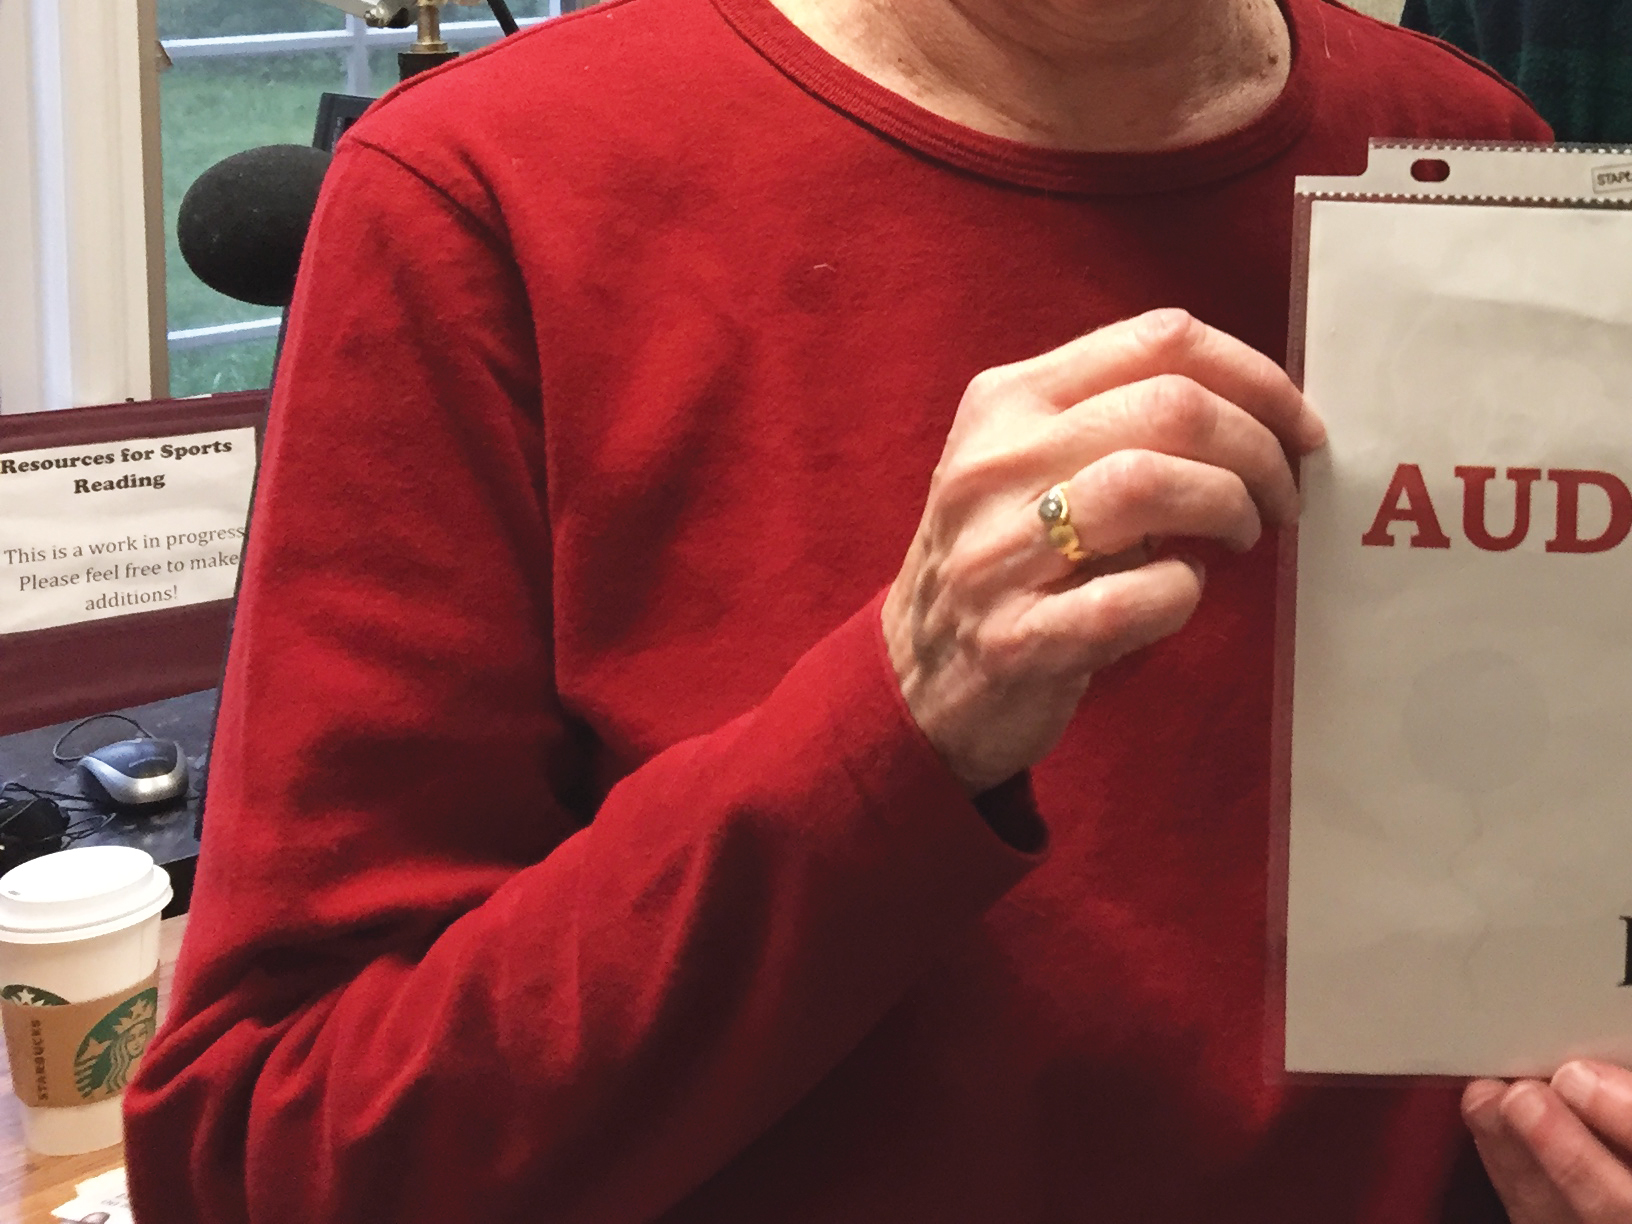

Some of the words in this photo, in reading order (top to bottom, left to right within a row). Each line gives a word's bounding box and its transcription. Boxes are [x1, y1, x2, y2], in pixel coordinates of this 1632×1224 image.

[0, 452, 115, 474] Resources
[120, 448, 155, 462] for
[160, 439, 233, 460] Sports
[73, 473, 166, 494] Reading
[4, 548, 46, 565] This
[52, 545, 67, 560] is
[72, 545, 84, 558] a
[88, 536, 138, 555] work
[143, 534, 160, 549] in
[19, 572, 80, 591] Please
[85, 565, 119, 583] feel
[125, 563, 162, 578] free
[166, 560, 185, 573] to
[190, 551, 239, 570] make
[85, 585, 178, 611] additions!
[30, 1019, 49, 1102] STARBUCKS
